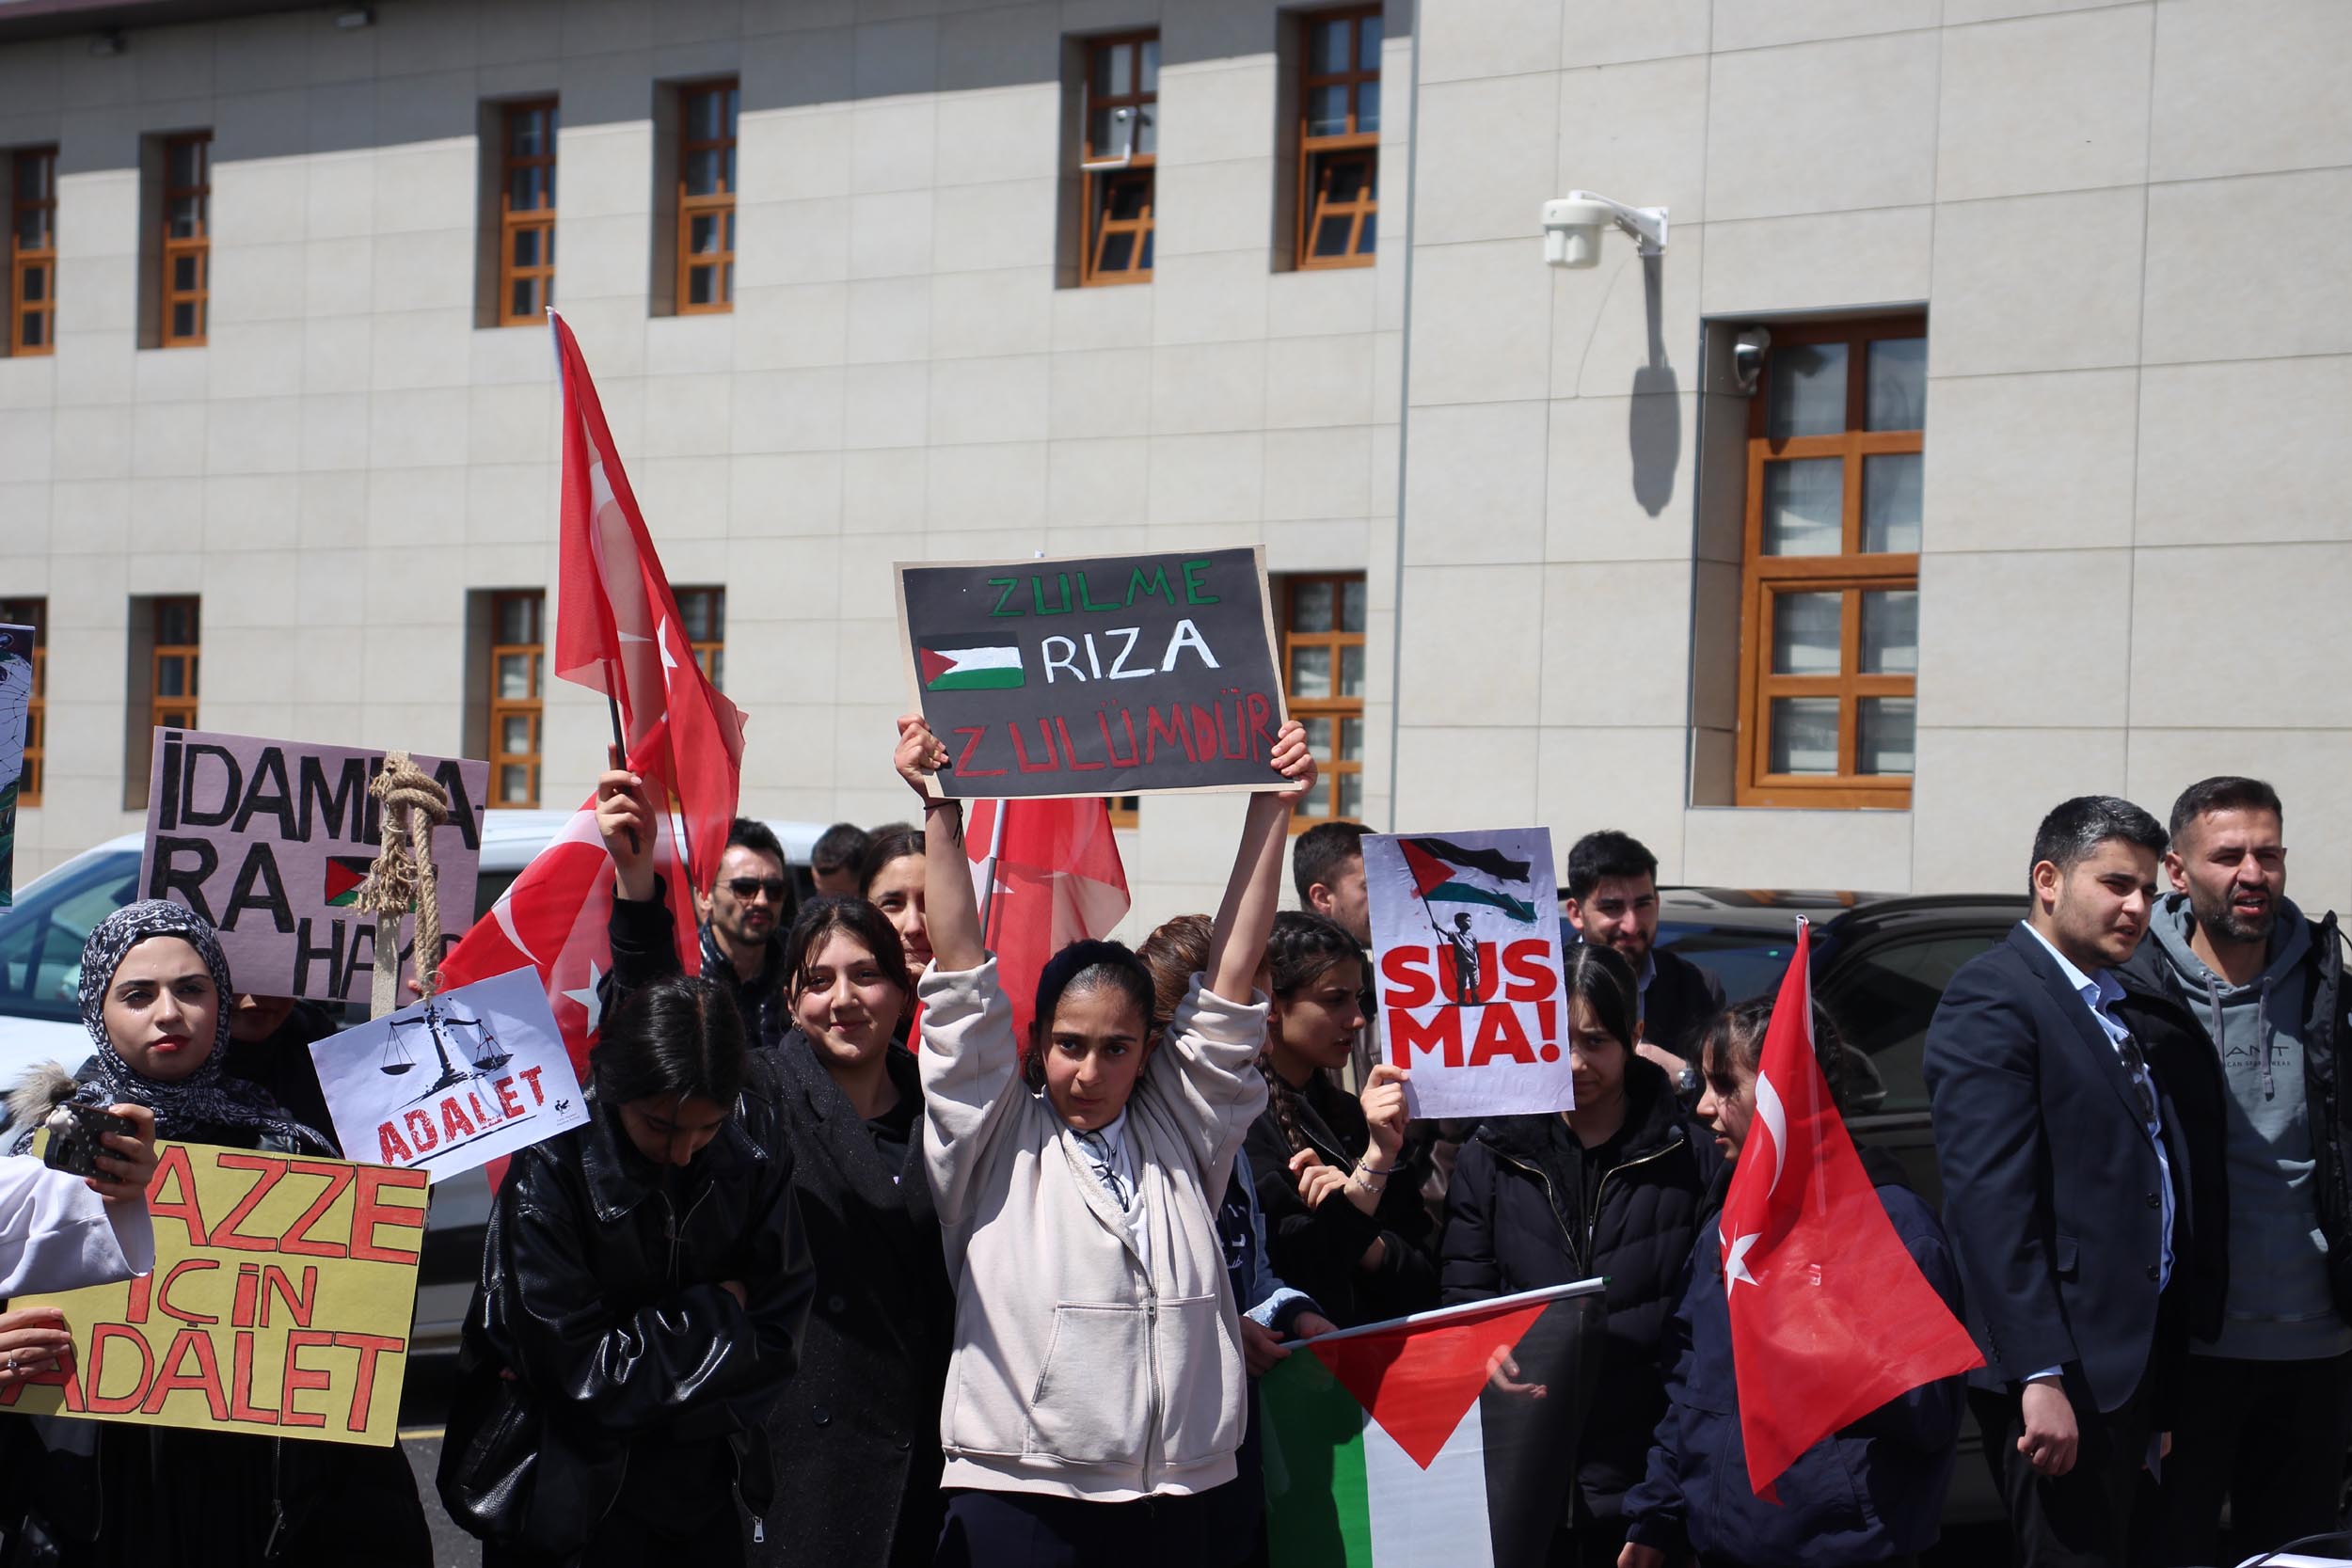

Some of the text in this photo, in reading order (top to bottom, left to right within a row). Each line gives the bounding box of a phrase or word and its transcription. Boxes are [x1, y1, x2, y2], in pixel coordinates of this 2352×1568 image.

[988, 560, 1220, 617] ZULME
[1041, 619, 1220, 683] RIZA
[953, 689, 1277, 777] ZULÜMDÜR
[149, 835, 294, 933] RA
[1381, 939, 1557, 1008] SUS
[1388, 1001, 1560, 1069] MA!
[2226, 1045, 2289, 1057] ANT
[377, 1065, 544, 1165] ADALET
[148, 1146, 428, 1266] AZZE
[0, 1320, 405, 1433] ADALET
